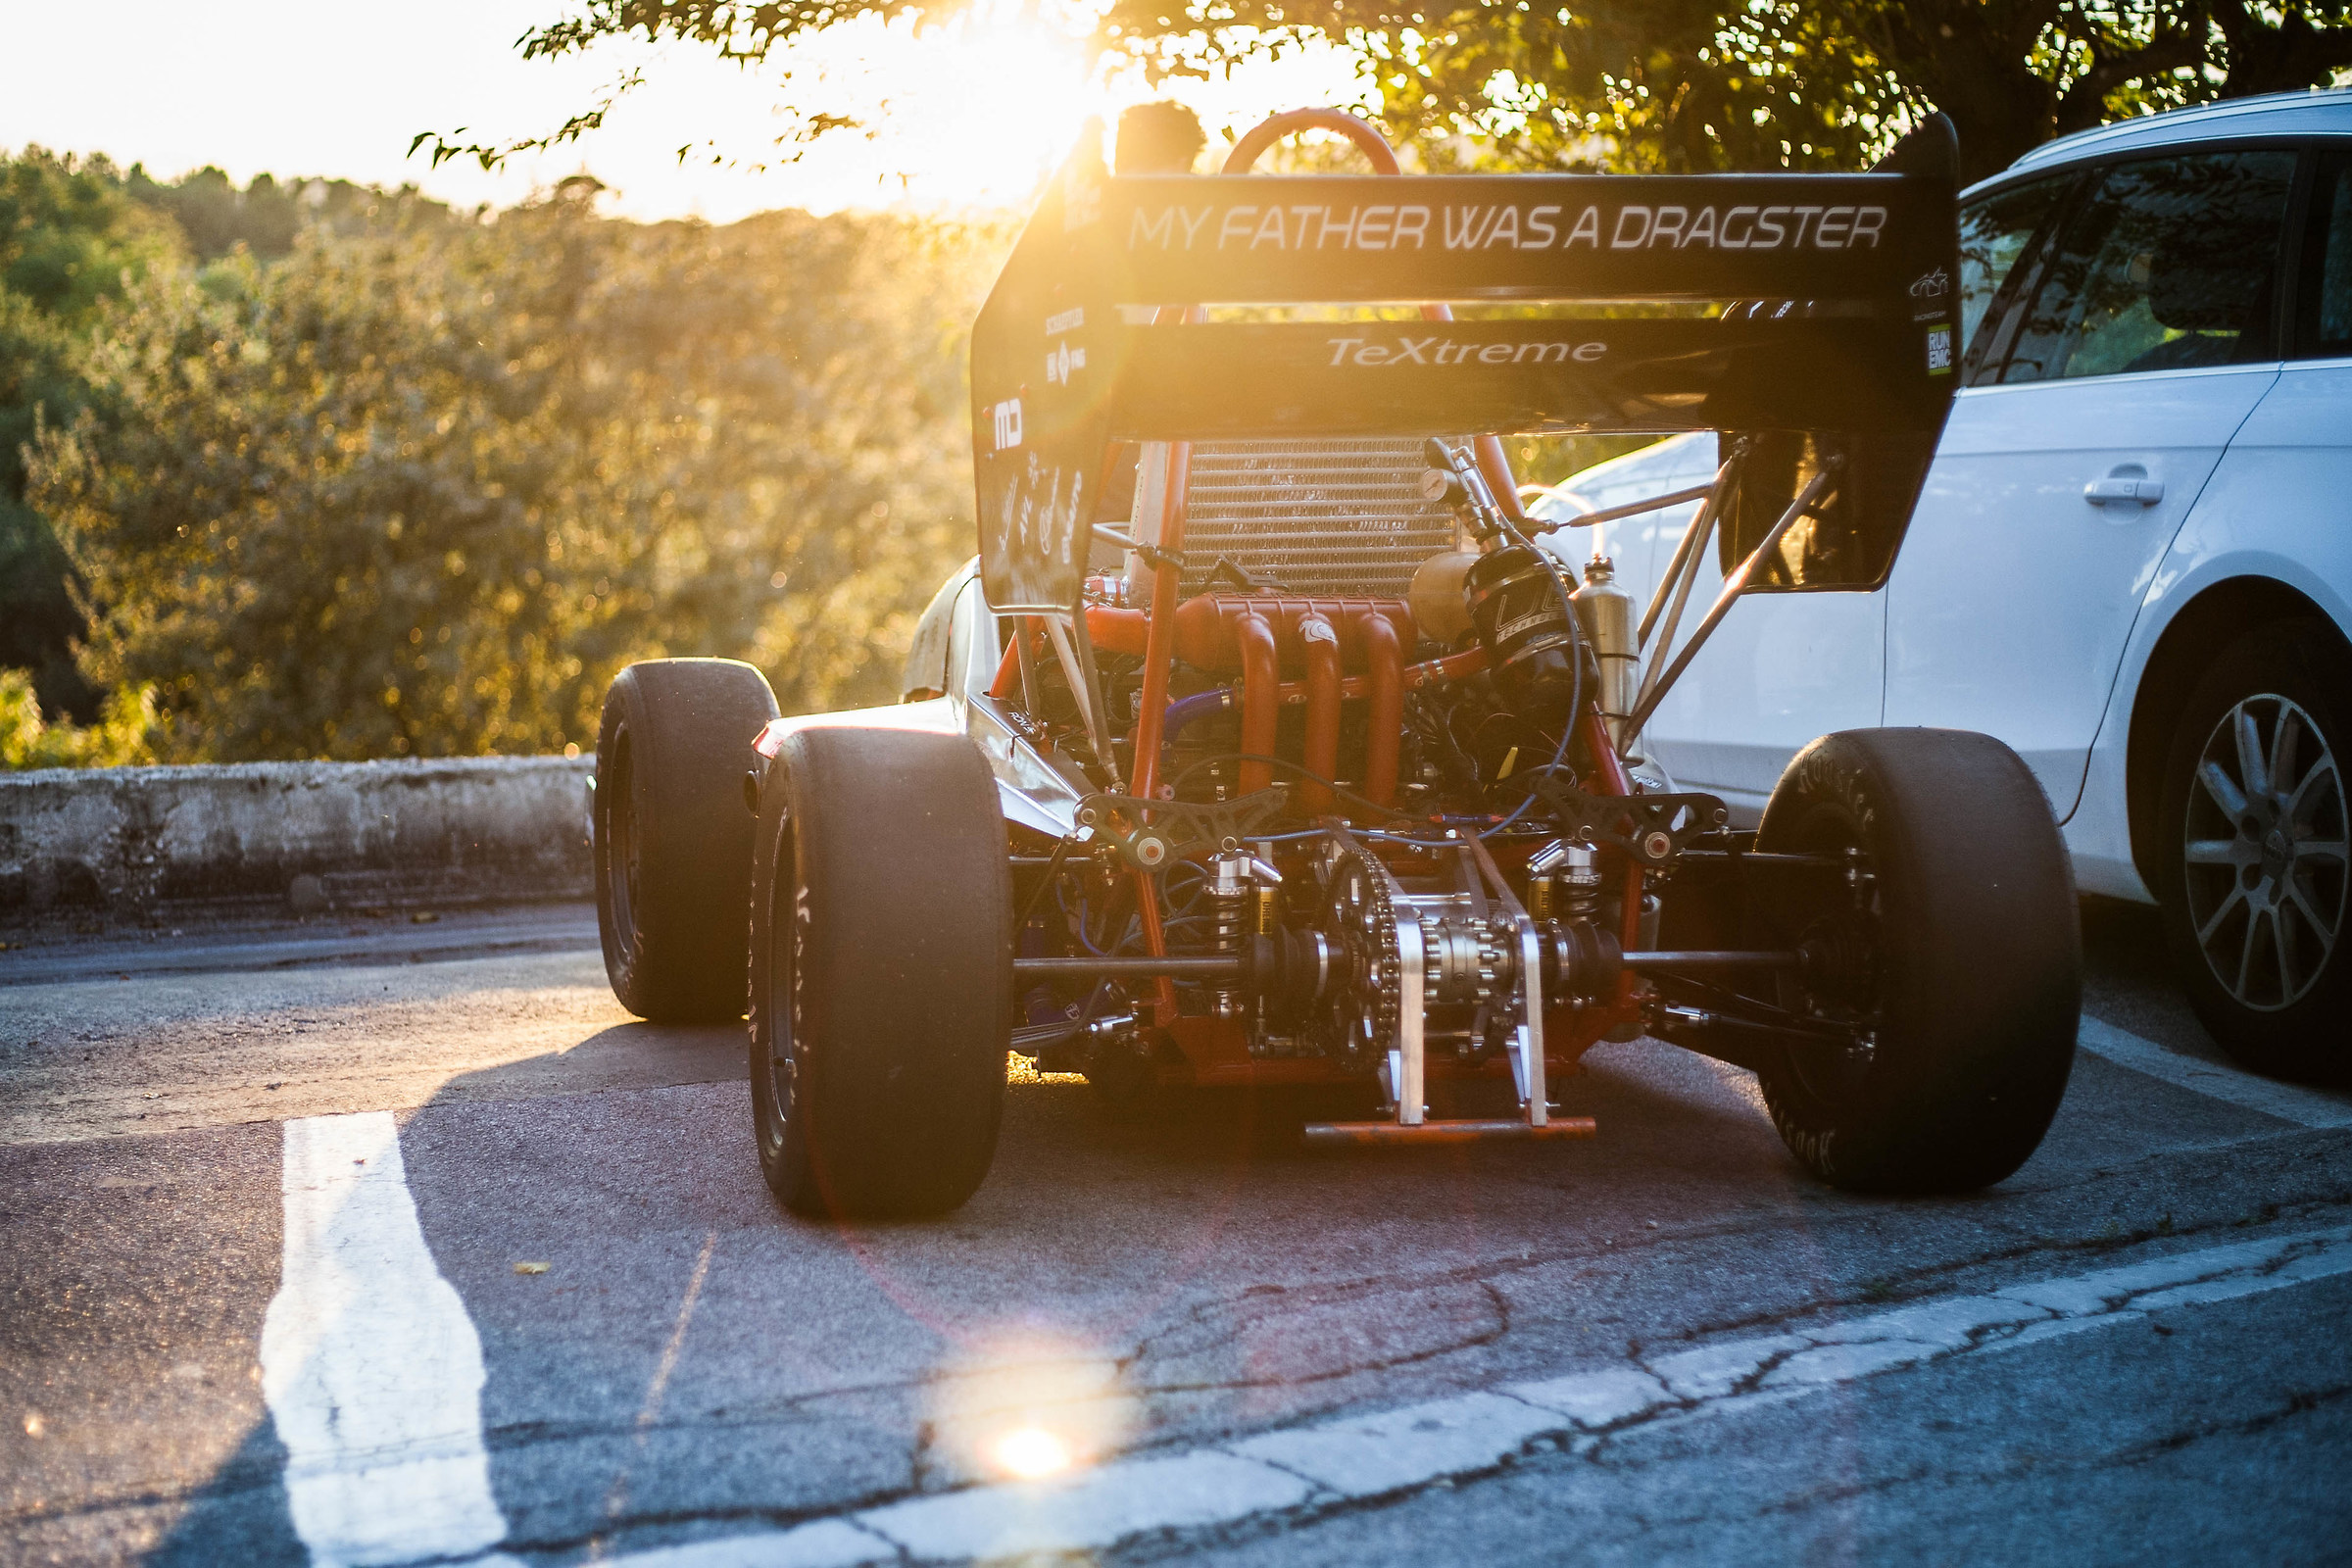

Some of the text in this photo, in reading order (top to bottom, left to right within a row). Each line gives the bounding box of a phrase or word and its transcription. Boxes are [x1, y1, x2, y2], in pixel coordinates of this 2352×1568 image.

[1128, 206, 1213, 250] MY
[1218, 206, 1430, 250] FATHER
[1445, 206, 1561, 250] WAS
[1565, 206, 1599, 249] A
[1610, 206, 1887, 249] DRAGSTER
[1327, 337, 1607, 367] TeXtreme
[1929, 330, 1950, 350] RUN
[1929, 350, 1951, 368] EMC
